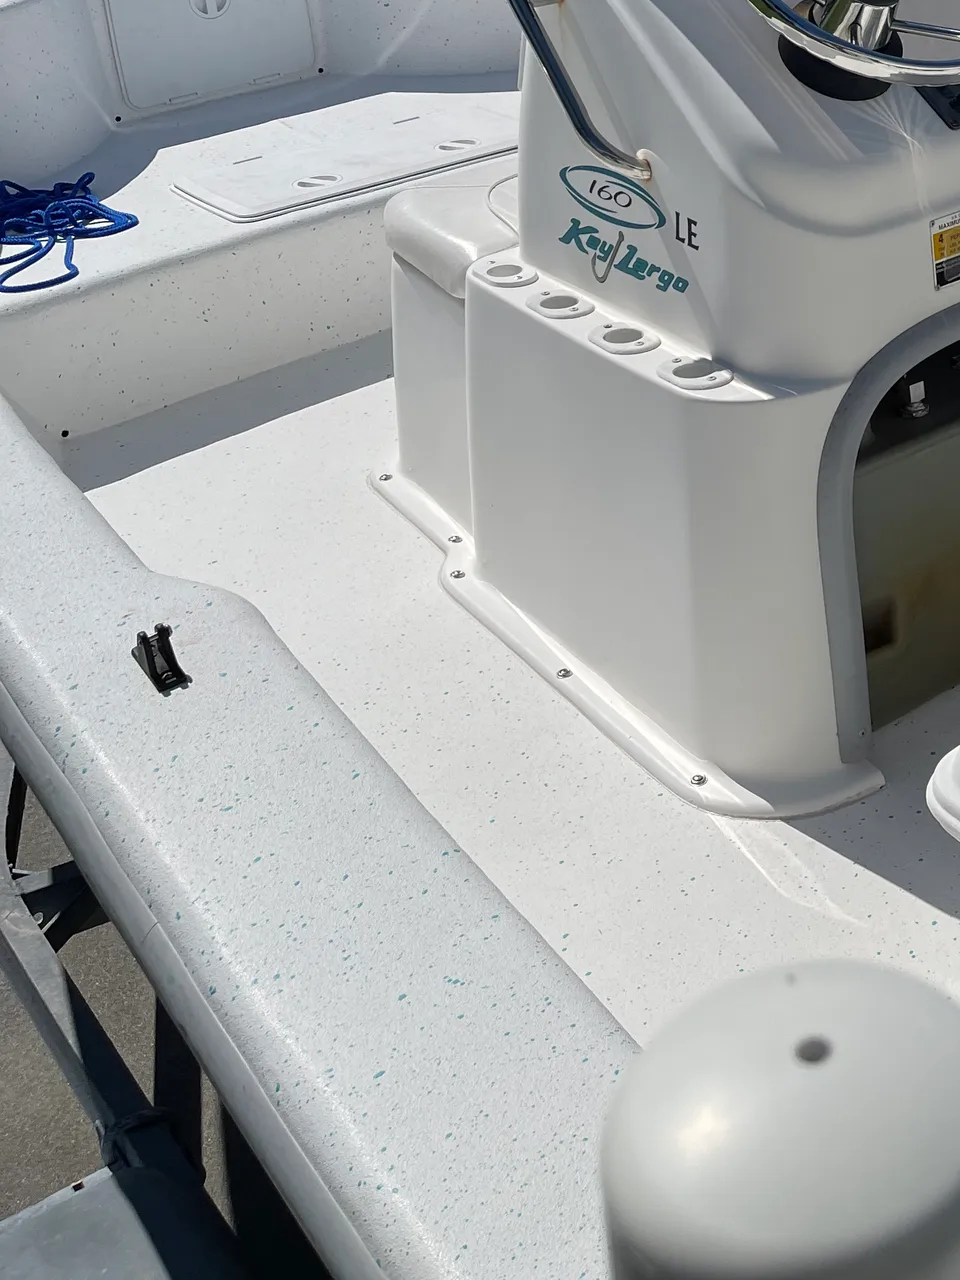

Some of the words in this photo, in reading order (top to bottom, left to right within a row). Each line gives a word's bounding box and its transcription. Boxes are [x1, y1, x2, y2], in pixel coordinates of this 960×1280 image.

[589, 179, 632, 208] 160
[675, 211, 700, 251] LE
[938, 233, 944, 243] 4
[558, 218, 614, 263] Key
[613, 244, 690, 294] Largo
